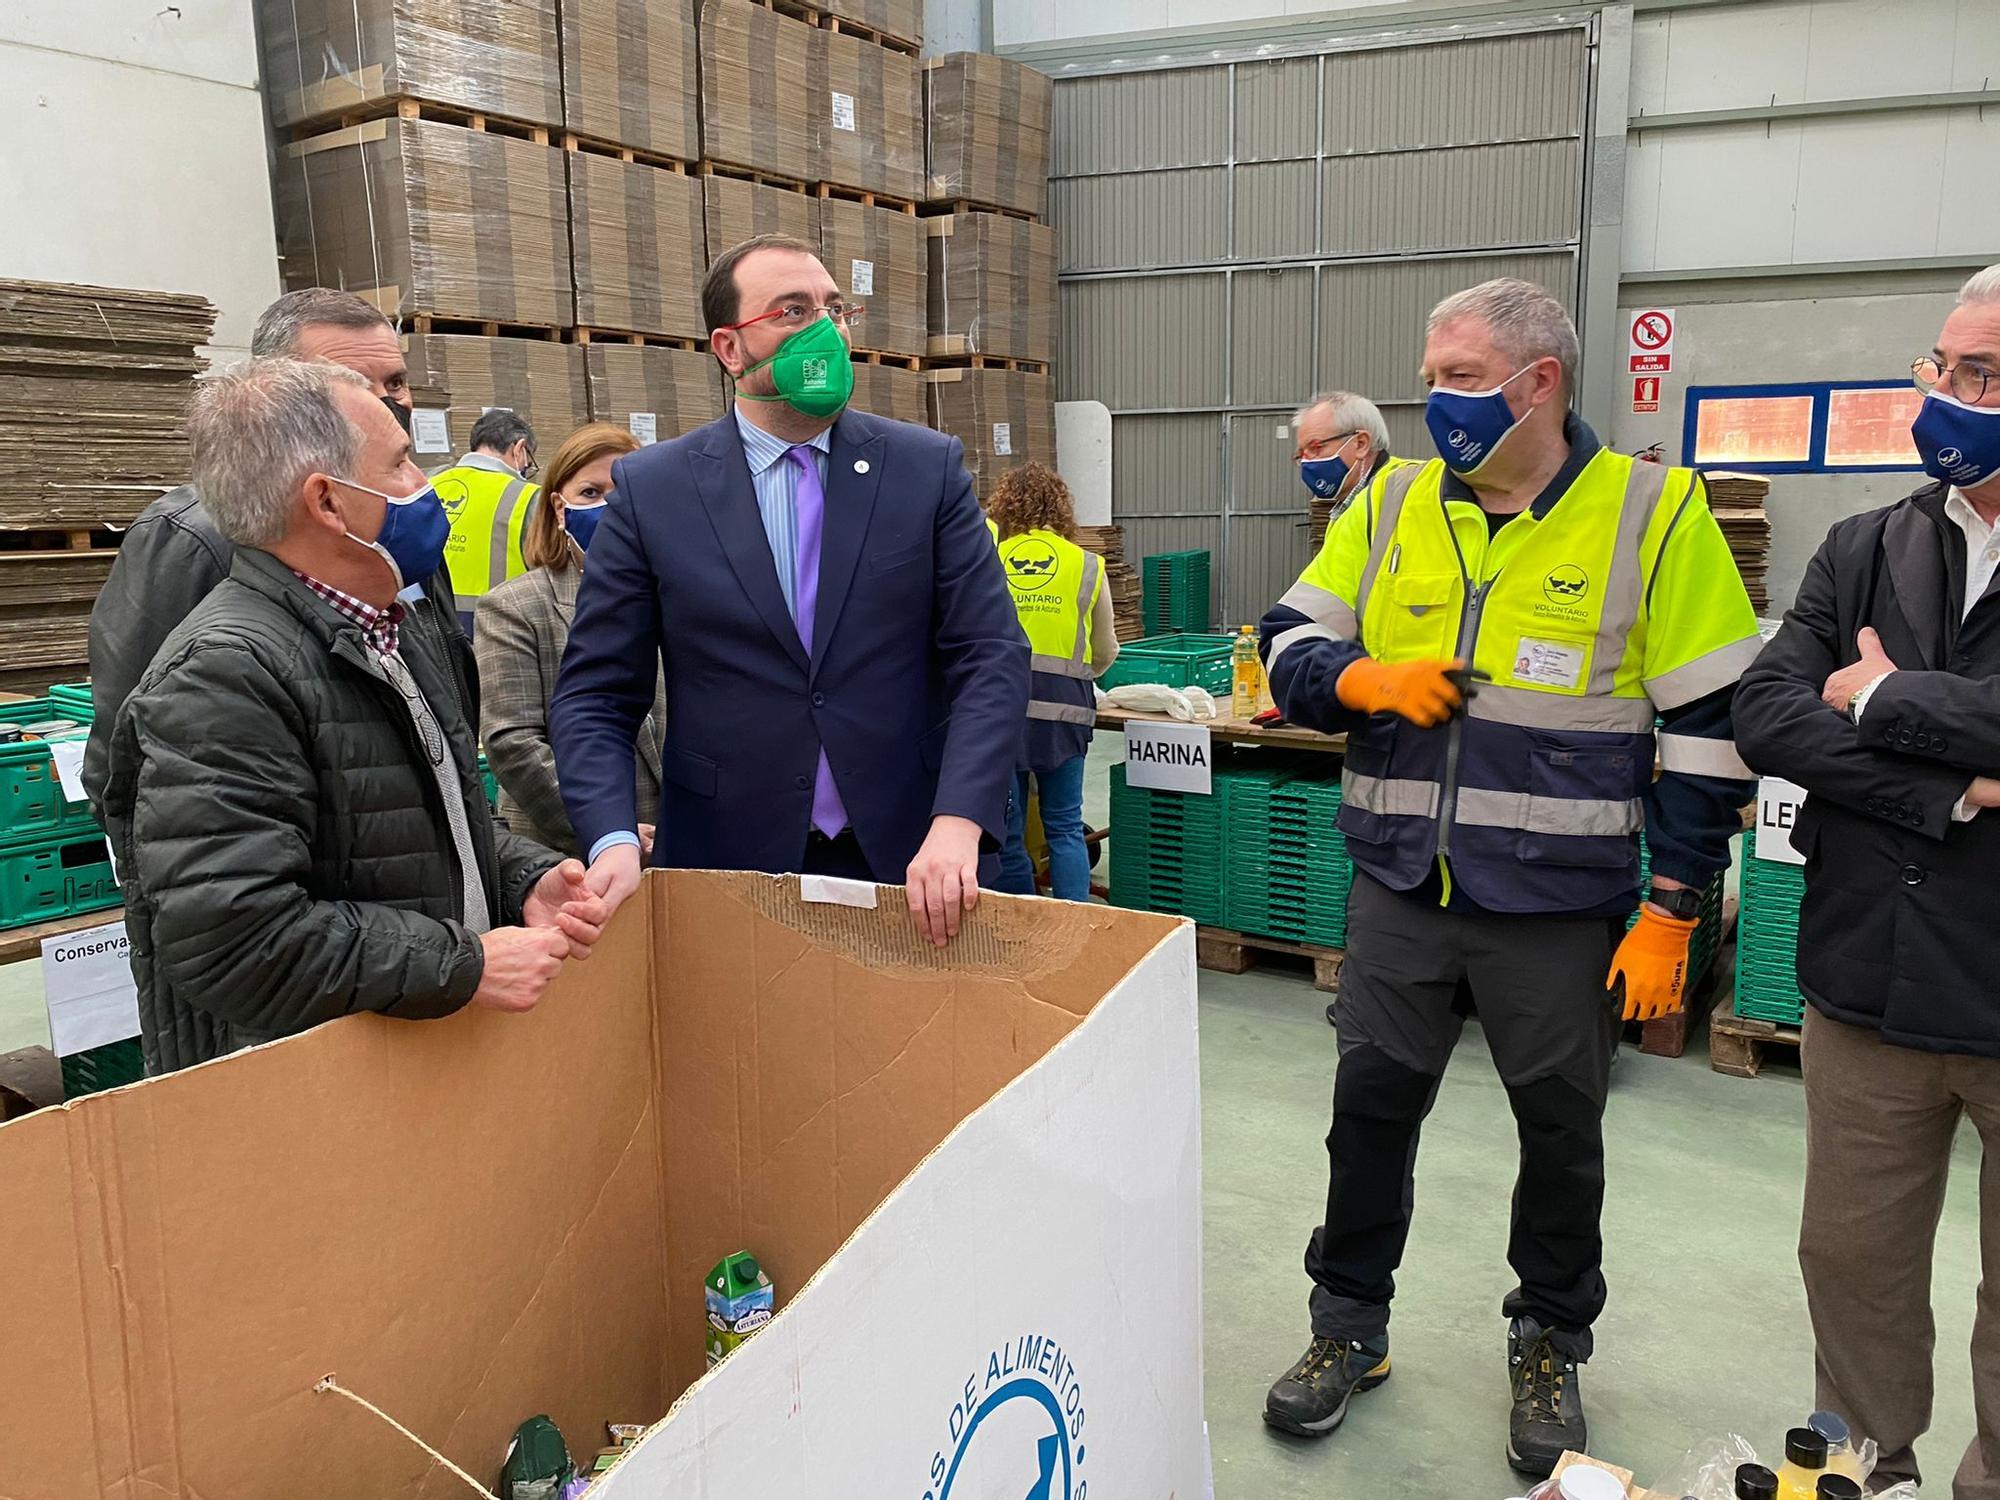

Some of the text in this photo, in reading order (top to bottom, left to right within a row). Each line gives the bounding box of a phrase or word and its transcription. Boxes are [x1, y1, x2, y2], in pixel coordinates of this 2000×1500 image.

[1014, 594, 1062, 604] UNTARIO
[1535, 603, 1588, 617] VOLUNTARIO
[1129, 740, 1206, 767] HARINA
[1763, 801, 1800, 829] LE
[55, 937, 131, 962] Conserva
[949, 1372, 978, 1444] DE
[985, 1334, 1085, 1440] ALIMENTOS
